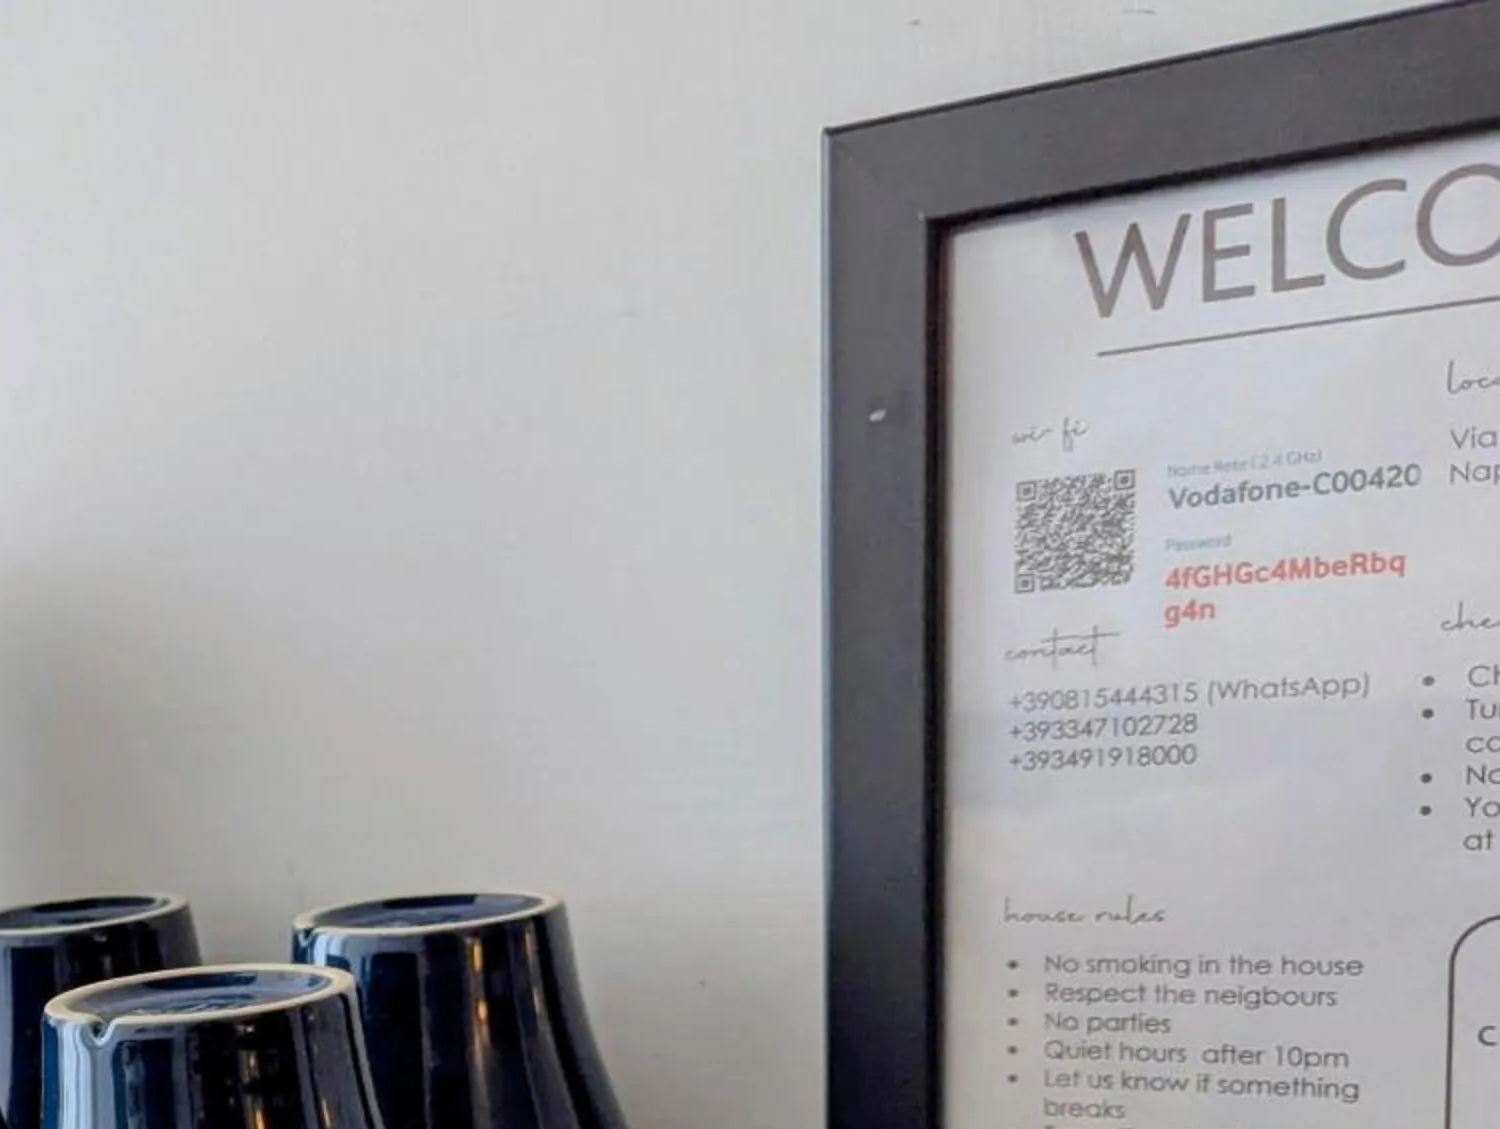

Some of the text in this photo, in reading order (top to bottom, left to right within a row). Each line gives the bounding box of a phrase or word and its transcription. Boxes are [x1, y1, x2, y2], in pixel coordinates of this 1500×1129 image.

[1074, 163, 1500, 318] WELCO
[1449, 425, 1498, 449] Via
[1168, 463, 1422, 510] Vodafone-C00420
[1164, 534, 1232, 553] Password
[1164, 599, 1216, 628] g4n
[1005, 624, 1120, 669] contact
[1009, 673, 1370, 712] +390815444315 (WhatsApp)
[1465, 698, 1500, 720] Tu
[1009, 713, 1198, 741] +393347102728
[1009, 744, 1198, 771] +393491918000
[1463, 828, 1496, 851] at
[1003, 894, 1166, 925] house rules
[1044, 955, 1364, 978] No smoking in the house
[1044, 984, 1338, 1010] Respect the neigbours
[1044, 1013, 1172, 1035] No parties
[1044, 1040, 1349, 1071] Quiet hours after 10pm
[1044, 1071, 1360, 1103] Let us know if something
[1043, 1099, 1126, 1119] breaks
